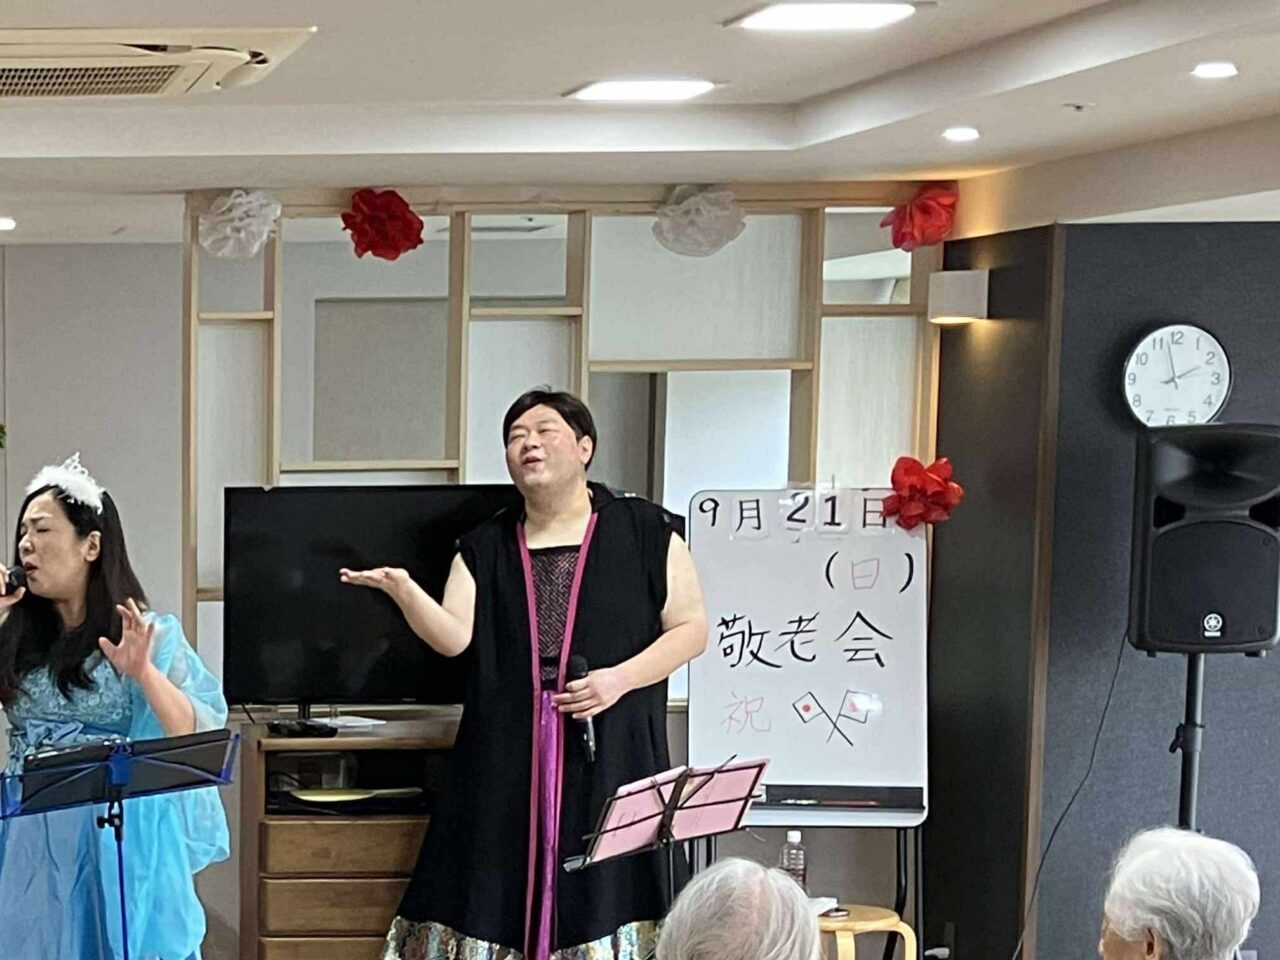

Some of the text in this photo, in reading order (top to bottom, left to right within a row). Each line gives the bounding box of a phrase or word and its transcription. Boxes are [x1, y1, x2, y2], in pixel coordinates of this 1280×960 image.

[1152, 338, 1164, 350] 11
[1170, 331, 1185, 345] 12
[1135, 352, 1149, 366] 10
[1205, 351, 1216, 365] 2
[1127, 372, 1137, 386] 9
[1211, 372, 1222, 386] 3
[1132, 394, 1142, 408] 8
[1203, 394, 1214, 408] 4
[1145, 410, 1154, 423] 7
[717, 611, 894, 668] 敬老会
[720, 690, 772, 734] 祝
